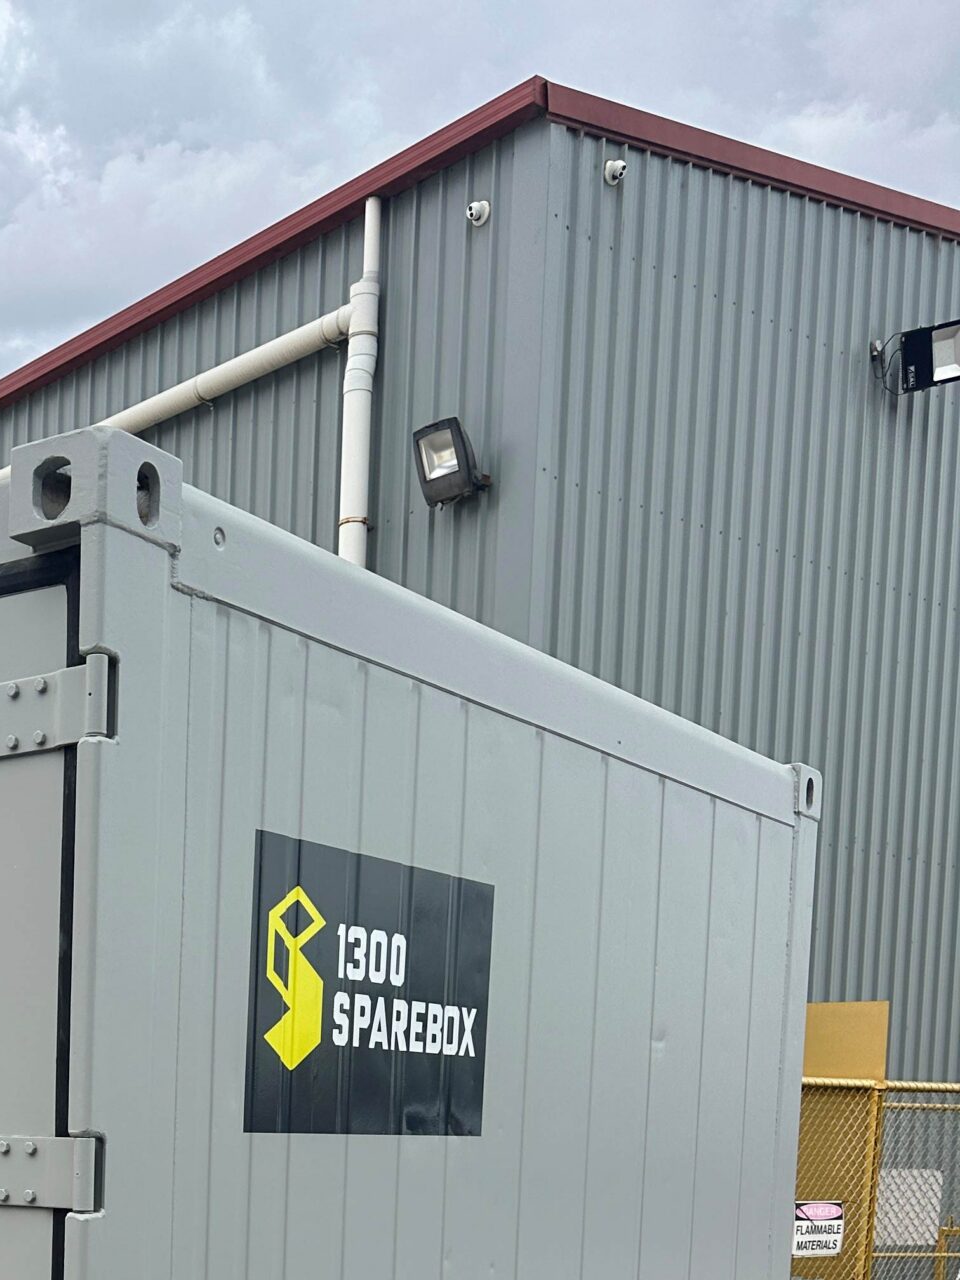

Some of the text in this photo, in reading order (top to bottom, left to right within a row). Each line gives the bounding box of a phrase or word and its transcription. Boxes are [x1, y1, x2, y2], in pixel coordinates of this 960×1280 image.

[337, 923, 407, 987] 1300
[332, 991, 478, 1058] SPAREBOX
[796, 1224, 842, 1235] FLAMMABLE
[796, 1239, 838, 1251] MATERIALS
